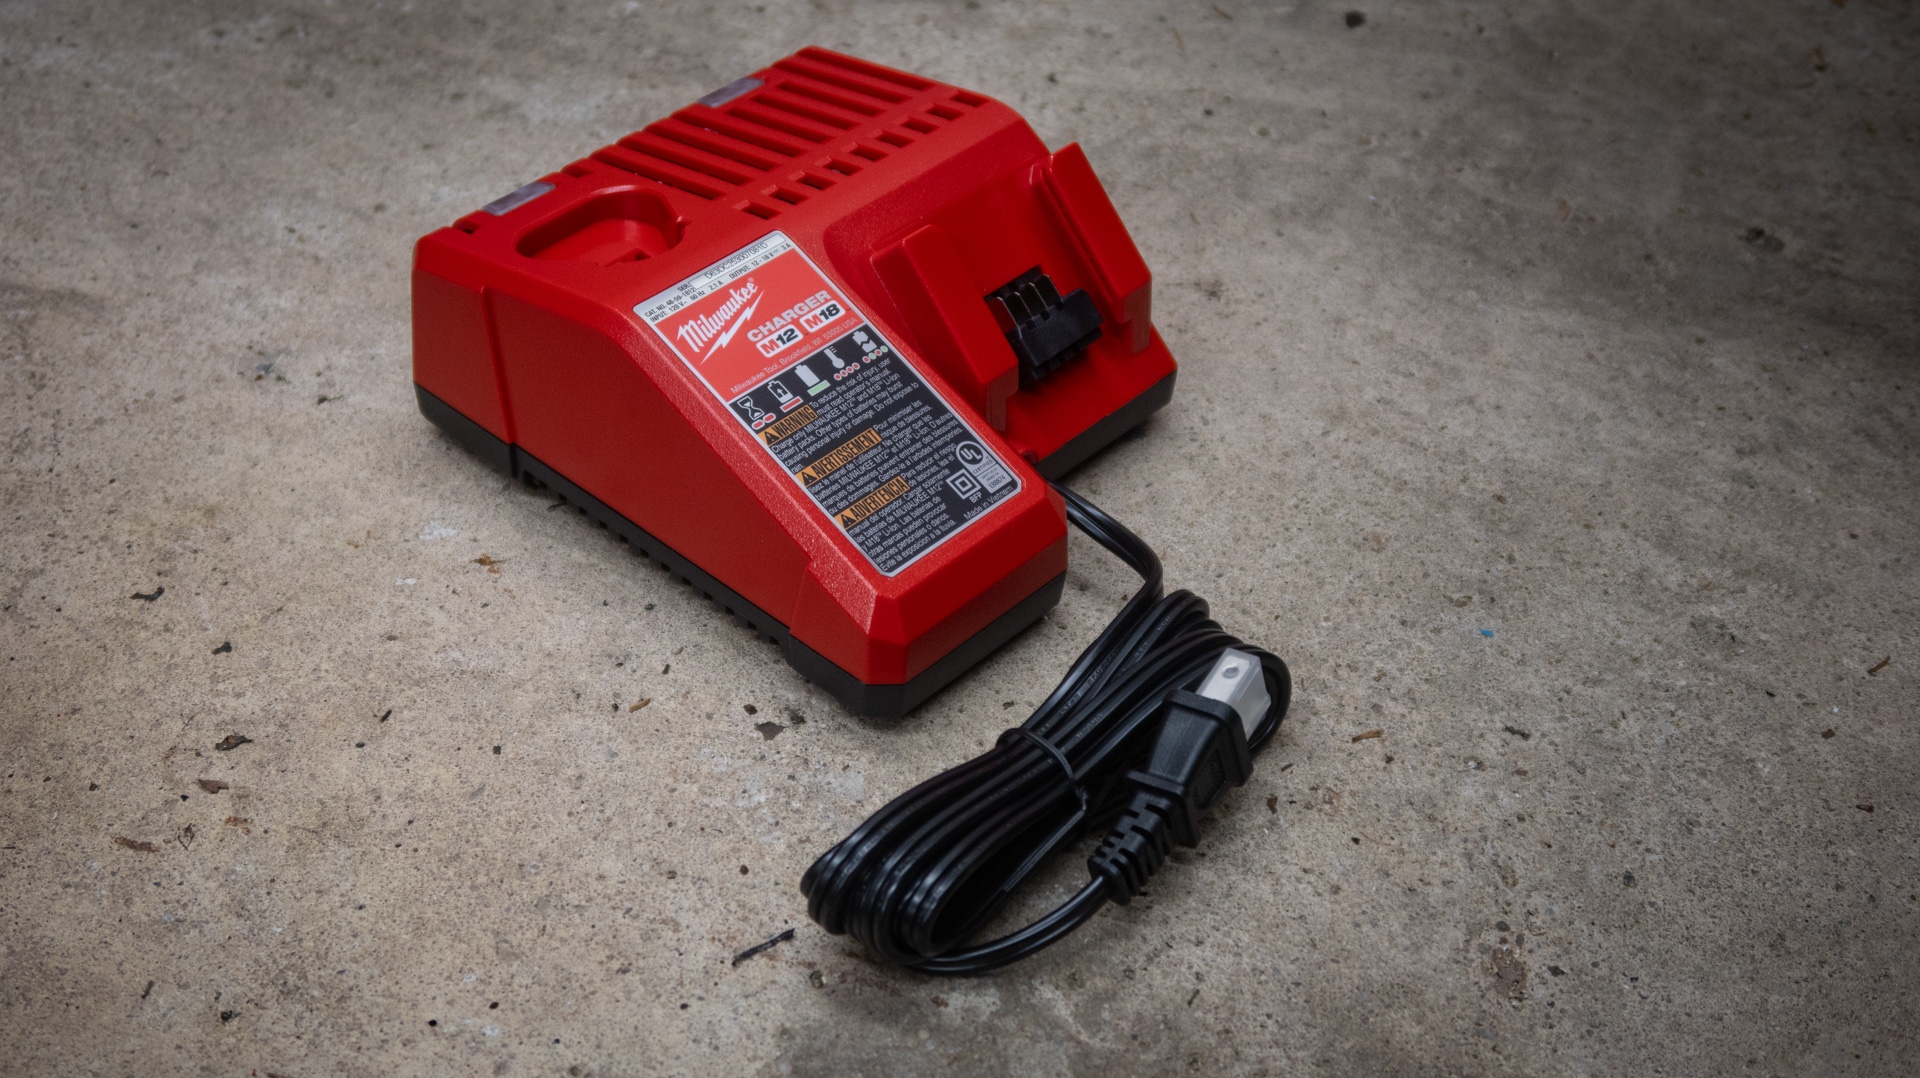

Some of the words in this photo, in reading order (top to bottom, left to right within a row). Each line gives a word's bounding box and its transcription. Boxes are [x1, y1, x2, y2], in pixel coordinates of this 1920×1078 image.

[650, 311, 667, 322] INPUT:
[729, 265, 750, 279] OUTPUT:
[666, 287, 696, 305] 48-59-1812
[747, 291, 831, 341] CHARGER
[730, 372, 765, 394] Milwaukee
[763, 363, 782, 374] Tool,
[779, 344, 814, 365] Brookfield,
[811, 337, 823, 346] WI
[823, 326, 843, 340] 53005
[841, 317, 858, 329] USA
[816, 404, 832, 416] must
[830, 396, 845, 407] read
[843, 381, 871, 399] operator's
[869, 368, 891, 384] manual.
[818, 391, 838, 404] reduce
[862, 366, 880, 378] injury,
[878, 358, 891, 368] user
[771, 438, 794, 453] Charge
[793, 430, 807, 441] only
[804, 408, 841, 433] MILWAUKEE
[857, 391, 869, 402] and
[882, 373, 900, 385] Li-Ion
[772, 407, 816, 437] WARNING
[777, 445, 799, 460] battery
[798, 435, 817, 449] packs.
[815, 424, 832, 437] Other
[831, 415, 848, 428] types
[852, 398, 877, 414] batteries
[876, 390, 890, 400] may
[887, 381, 903, 393] burst
[785, 451, 809, 467] causing
[806, 435, 831, 455] personal
[830, 427, 847, 439] injury
[851, 410, 875, 426] damage.
[873, 403, 885, 412] Do
[883, 396, 894, 406] not
[893, 386, 913, 400] expose
[873, 420, 888, 432] Pour
[887, 405, 913, 423] minimiser
[880, 426, 899, 439] risque
[903, 405, 932, 424] blessures,
[791, 464, 805, 474] rain.
[808, 482, 824, 494] lisez
[892, 426, 913, 442] charger
[912, 420, 924, 431] que
[811, 430, 878, 478] AVERTISSEMENT
[815, 483, 841, 501] batteries
[838, 460, 876, 485] MILWAUKEE
[912, 427, 931, 439] Li-Ion.
[929, 412, 953, 429] D'autres
[822, 490, 848, 508] marques
[853, 470, 879, 487] batteries
[899, 441, 923, 459] entrainer
[922, 435, 934, 444] des
[931, 419, 958, 438] blessures
[900, 469, 917, 480] Para
[915, 457, 934, 472] reducir
[939, 443, 959, 456] riesgo
[915, 465, 941, 482] lesiones,
[960, 448, 982, 460] UL
[837, 500, 849, 509] des
[848, 481, 880, 502] dommages.
[878, 463, 906, 482] Gardez-le
[849, 519, 870, 536] manual
[869, 513, 880, 523] del
[879, 498, 905, 517] operador.
[903, 486, 925, 501] Cargar
[922, 469, 950, 489] solamente
[850, 479, 908, 520] ADVERTENCIA
[963, 506, 983, 520] Made
[987, 486, 1013, 503] Vietnam
[969, 492, 982, 503] BFP
[863, 521, 887, 538] baterias
[893, 492, 930, 518] MILWAUKEE
[868, 545, 884, 557] otras
[882, 532, 904, 548] marcas
[902, 518, 924, 536] pueden
[923, 503, 947, 522] provocar
[899, 515, 913, 525] Las
[910, 501, 934, 518] baterias
[874, 547, 899, 564] lesiones
[897, 527, 927, 550] personales
[931, 513, 950, 527] danos.
[880, 559, 897, 571] Evite
[901, 536, 931, 558] exposicion
[939, 520, 957, 532] lluvia.
